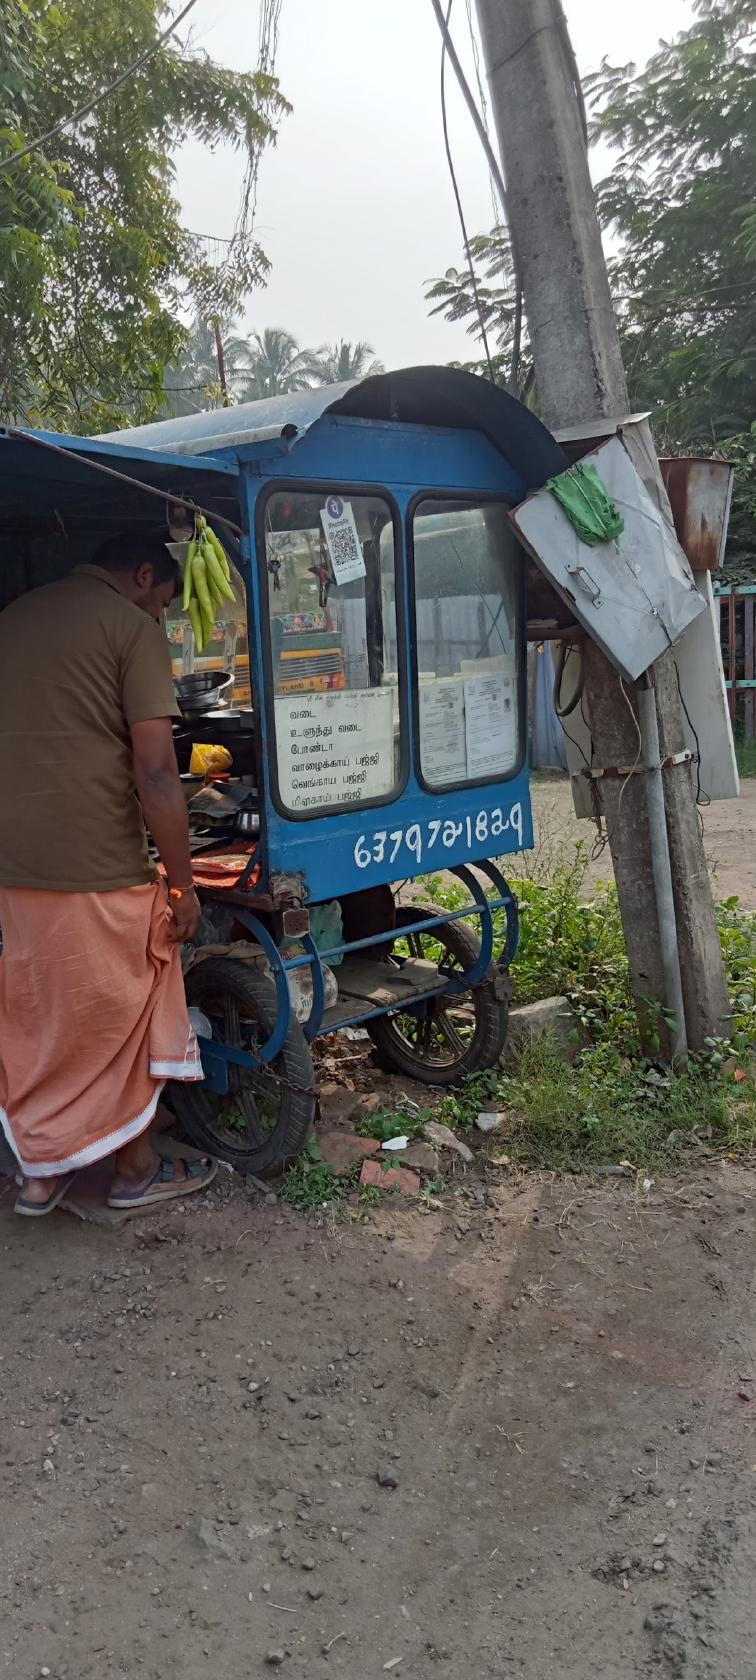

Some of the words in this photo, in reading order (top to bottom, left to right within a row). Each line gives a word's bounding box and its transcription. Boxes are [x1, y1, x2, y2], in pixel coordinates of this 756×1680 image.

[290, 710, 317, 719] வடை
[290, 725, 332, 738] உளுந்து
[338, 724, 362, 733] வடை
[291, 742, 333, 755] போண்டா
[291, 756, 350, 772] வாழைக்காய்
[355, 752, 380, 767] பஜ்ஜி
[342, 771, 367, 785] பஜ்ஜி
[337, 787, 362, 801] பஜ்ஜி
[354, 802, 522, 868] 6379721829
